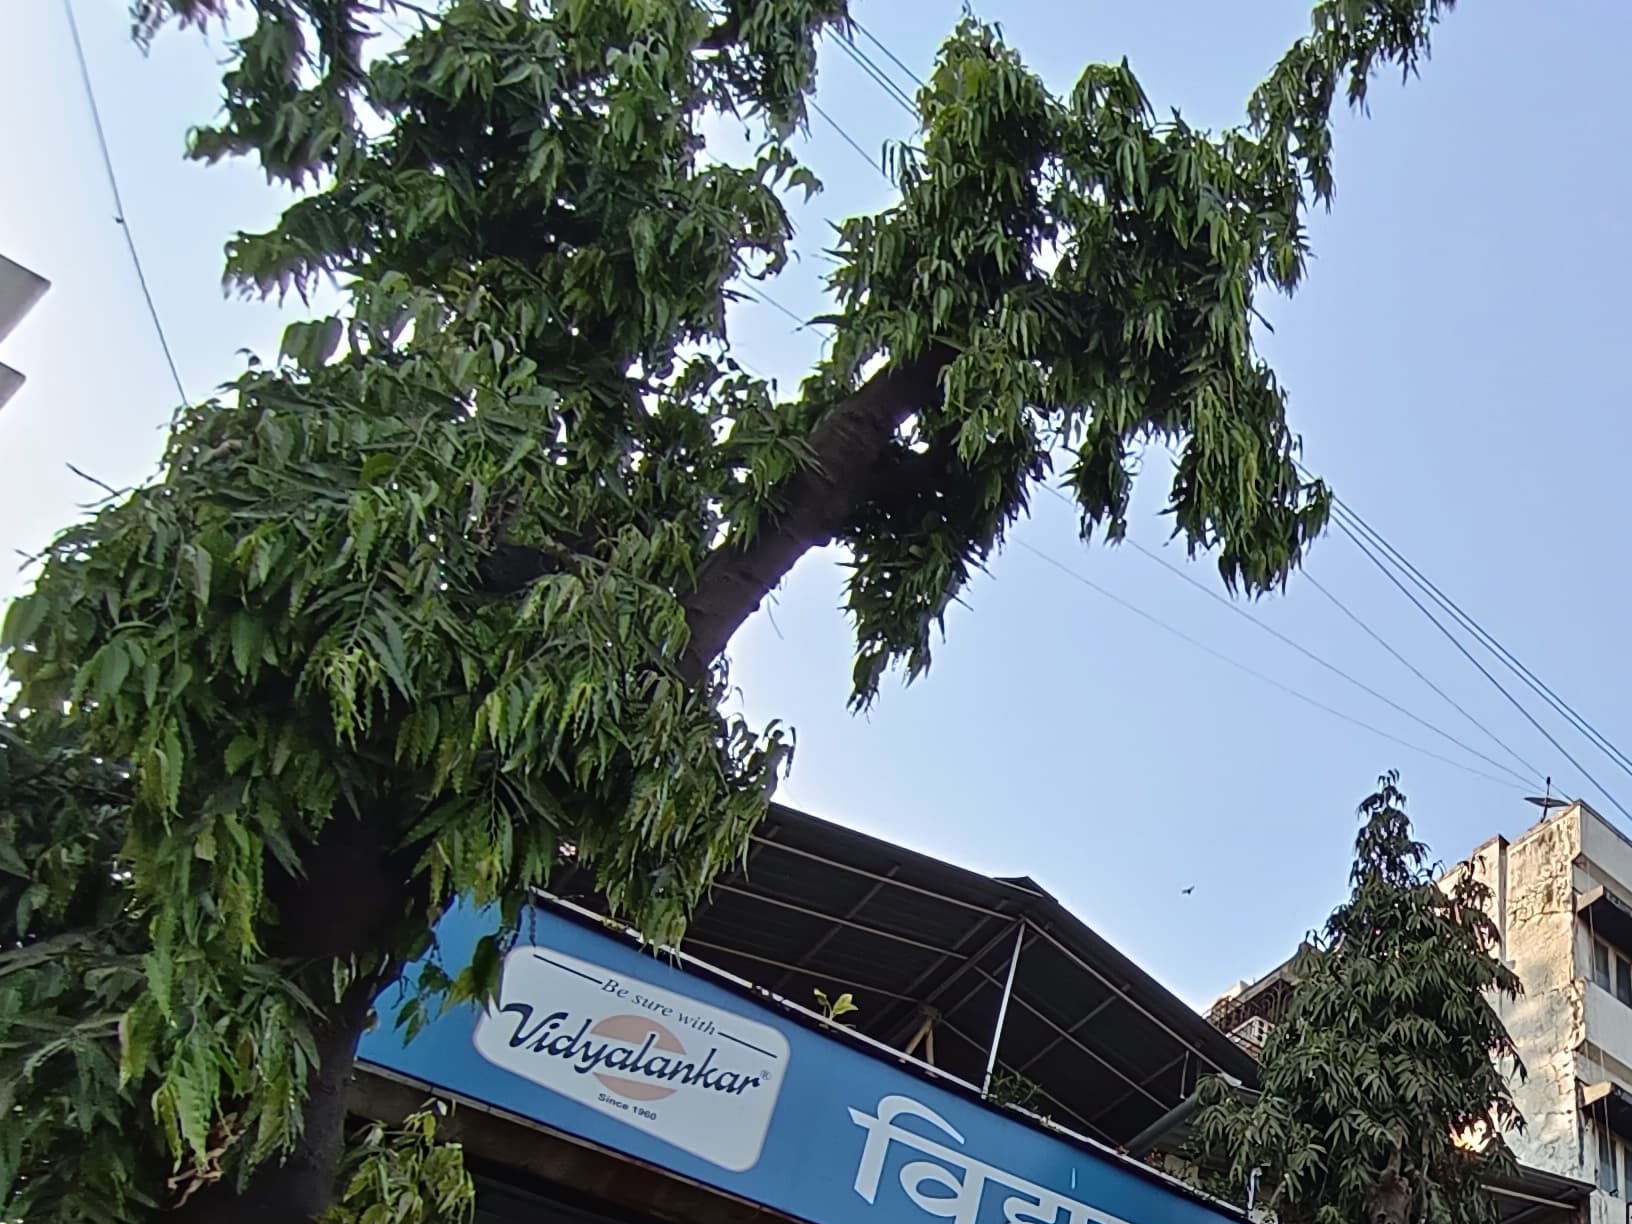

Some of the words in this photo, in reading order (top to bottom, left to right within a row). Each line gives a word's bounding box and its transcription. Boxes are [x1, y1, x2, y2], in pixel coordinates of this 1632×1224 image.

[602, 979, 629, 998] Be
[631, 993, 673, 1017] sure
[677, 1012, 716, 1036] with
[501, 1002, 765, 1096] Vidyalankar
[597, 1093, 629, 1111] Since
[632, 1105, 657, 1121] 1960
